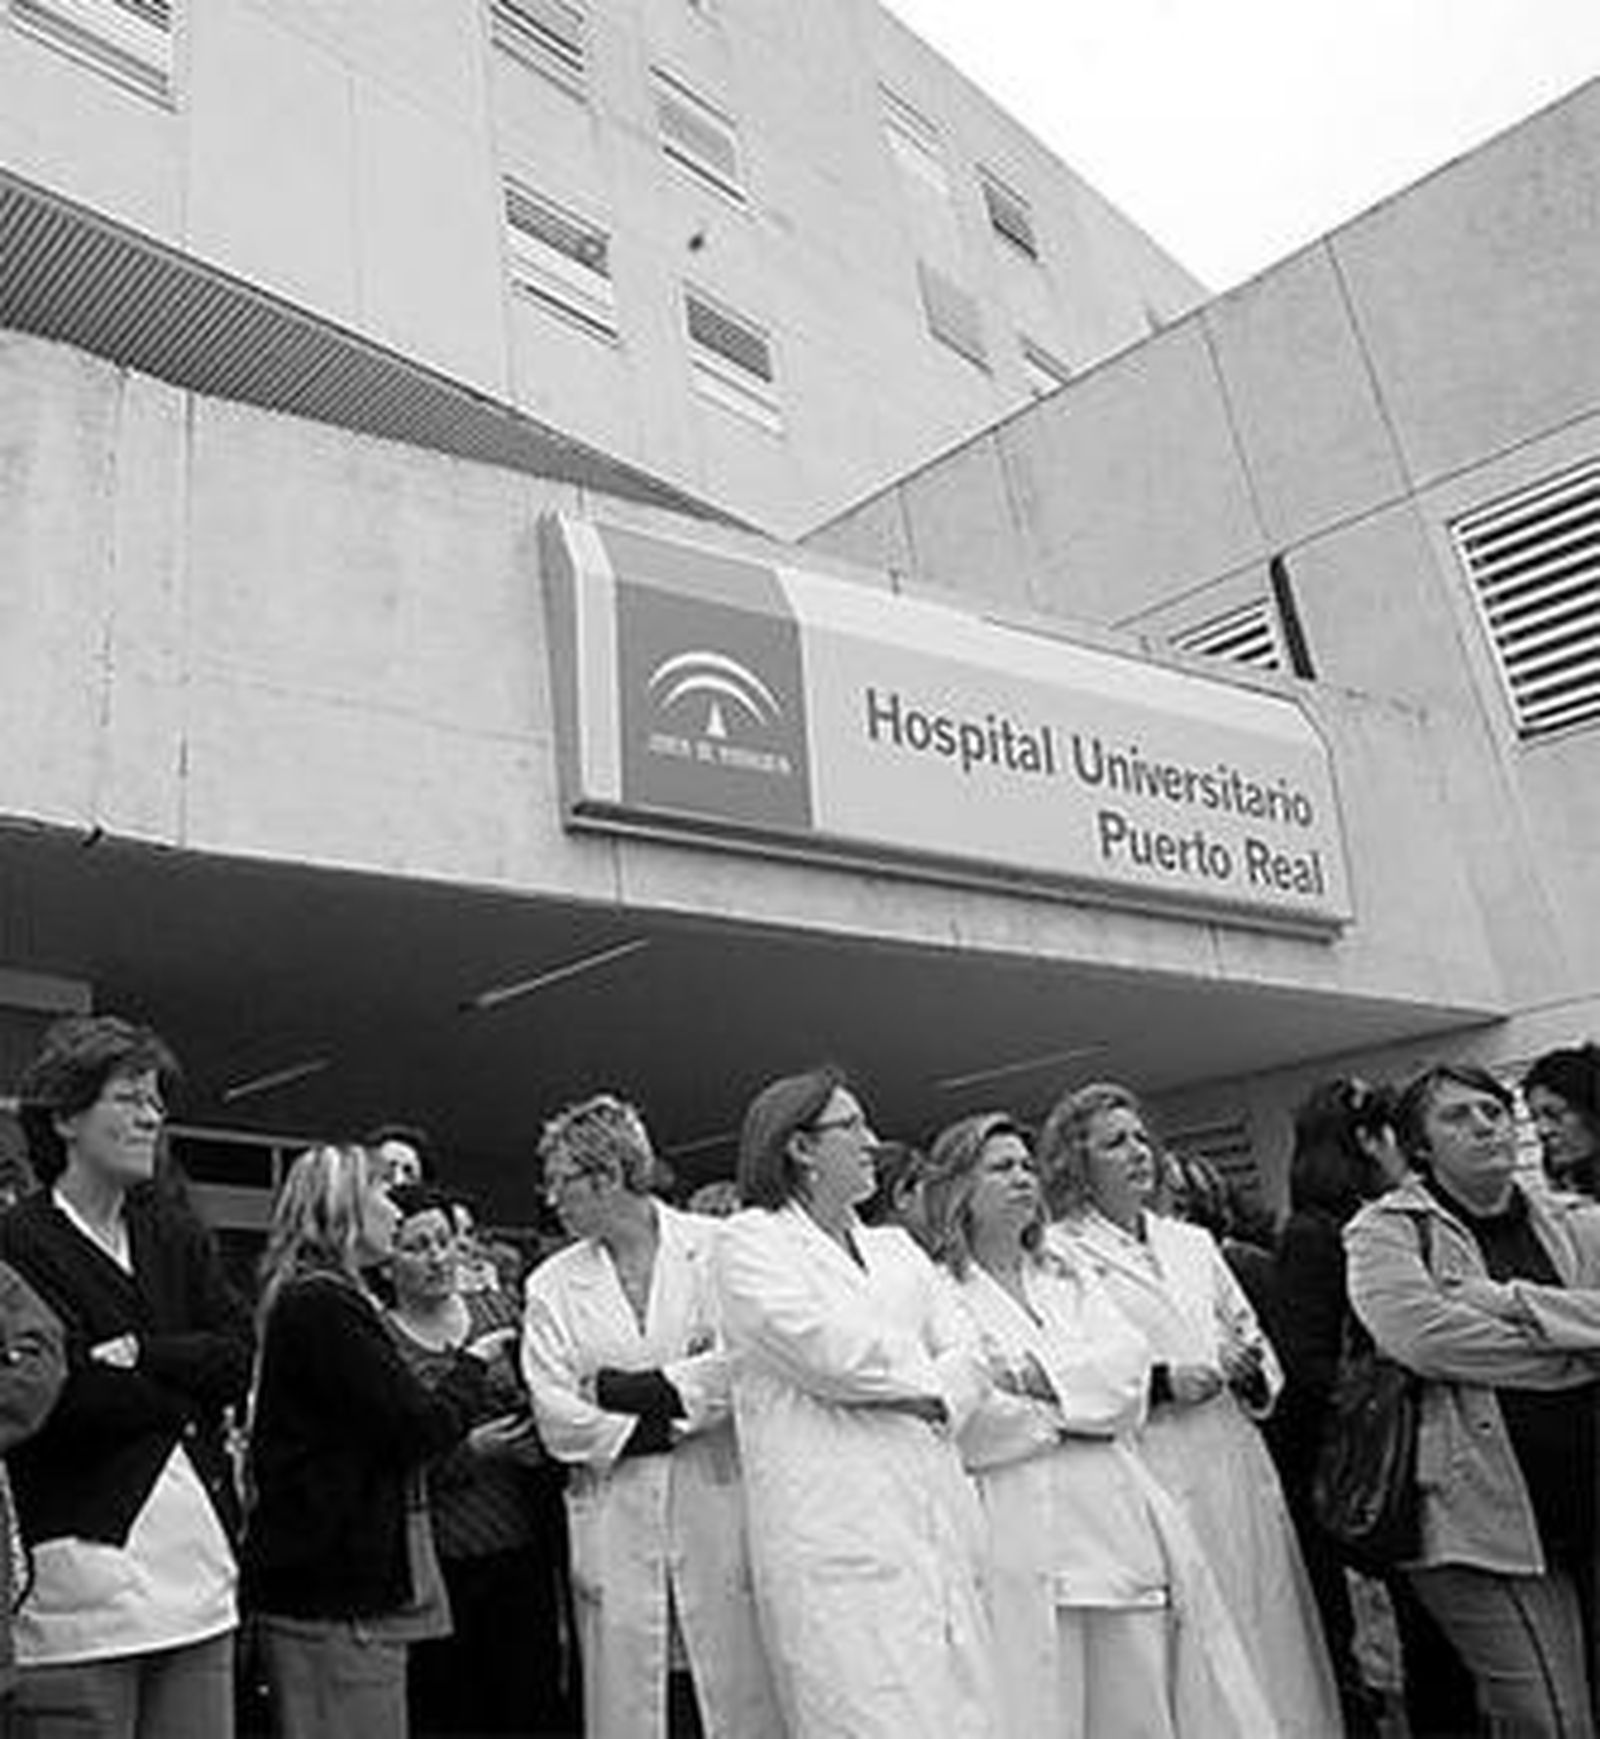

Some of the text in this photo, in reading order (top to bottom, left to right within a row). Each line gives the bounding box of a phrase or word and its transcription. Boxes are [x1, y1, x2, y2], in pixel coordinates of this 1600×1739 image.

[866, 687, 1055, 776] Hospital
[1072, 735, 1315, 828] Universitario
[1098, 809, 1325, 895] Puerto Real
